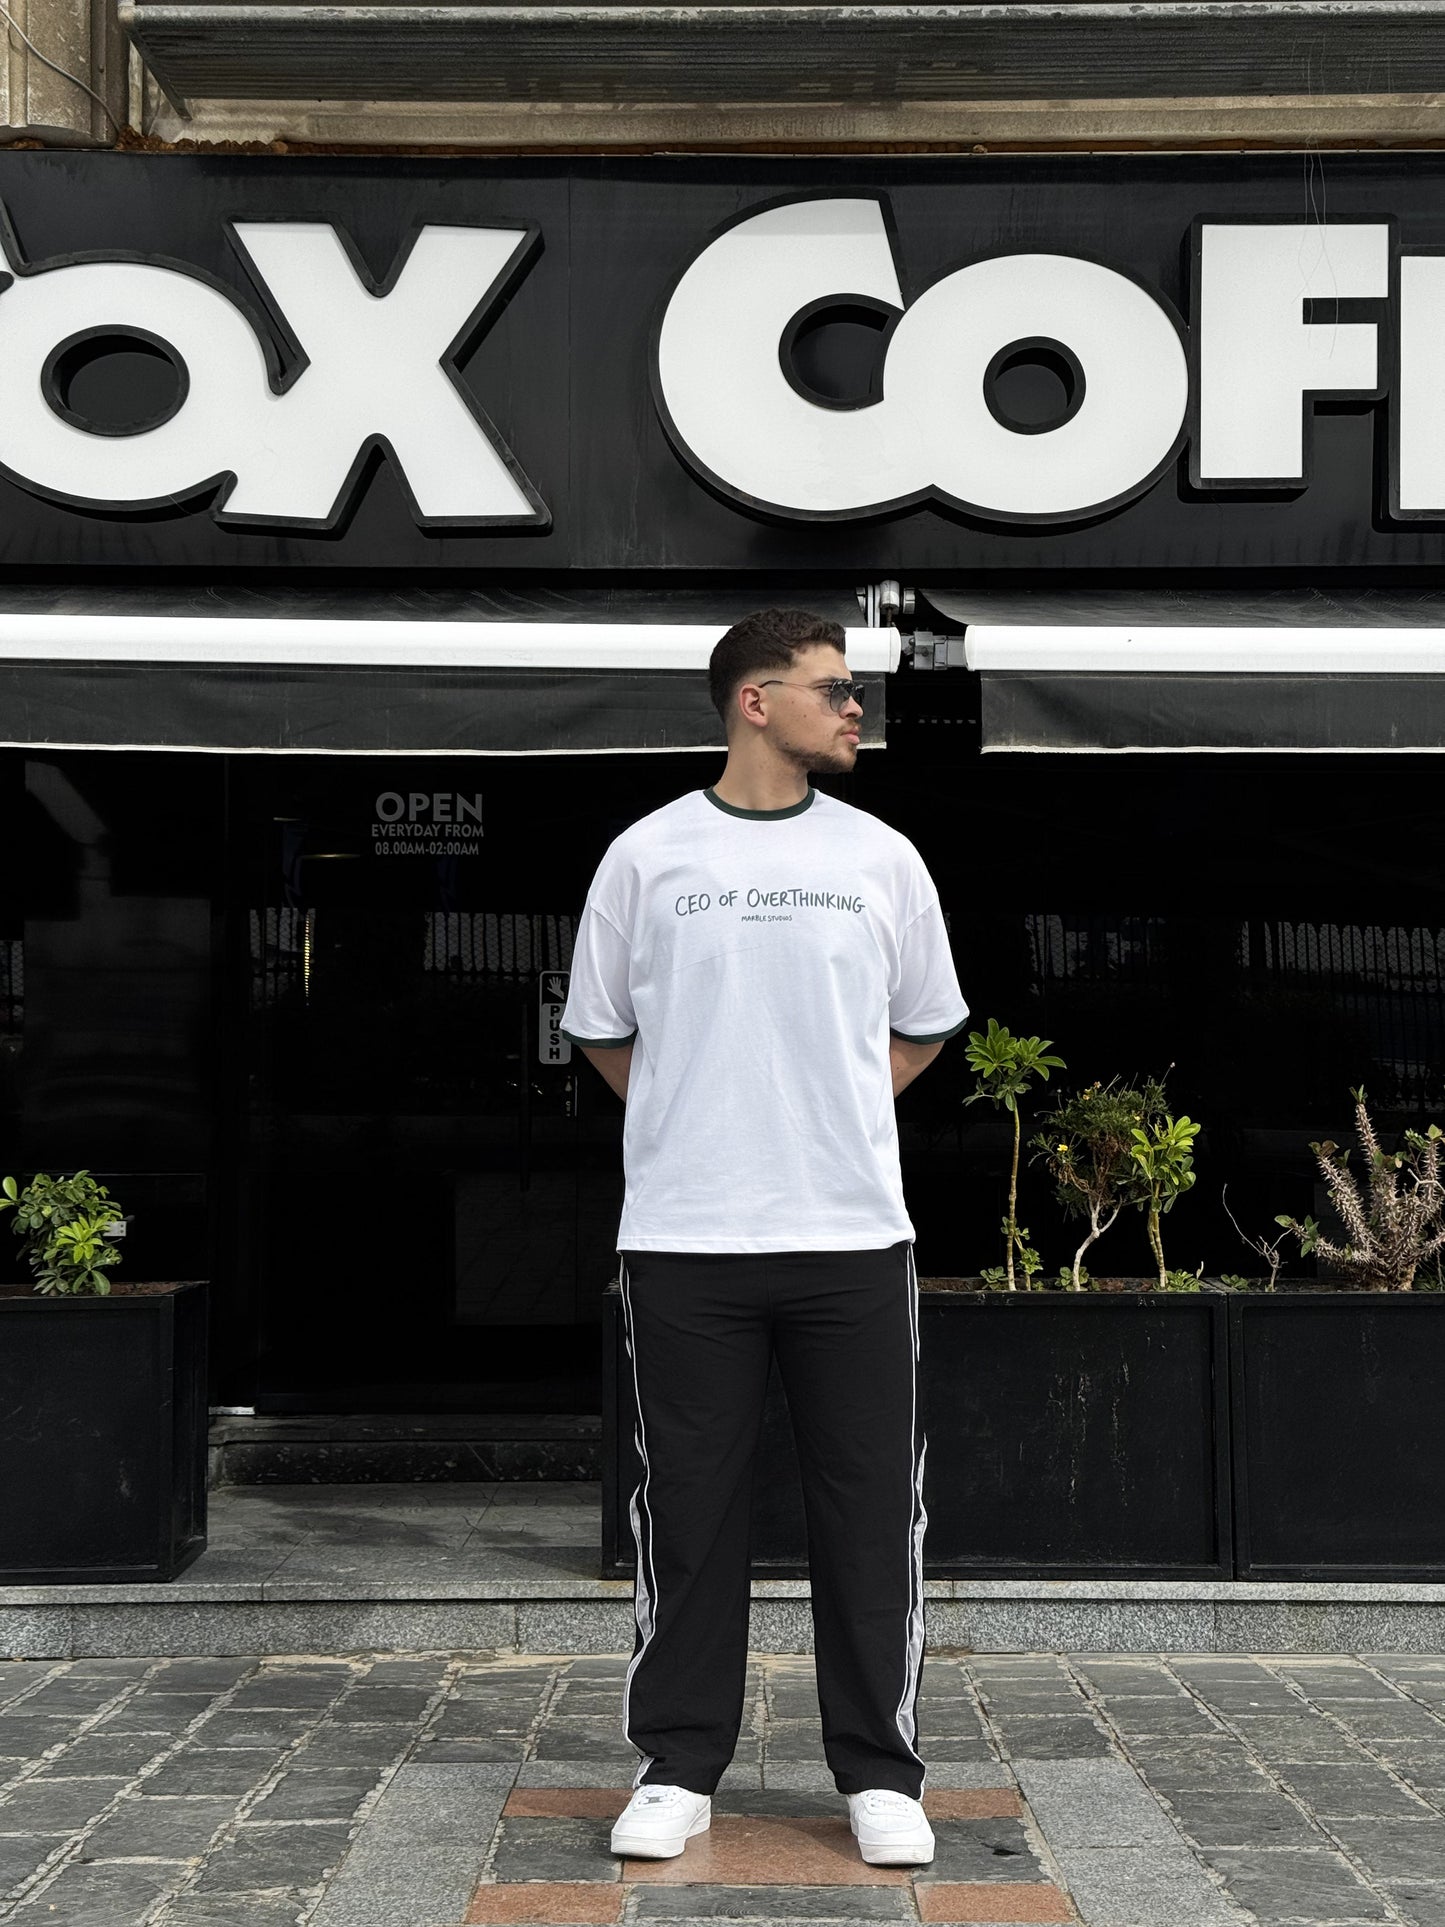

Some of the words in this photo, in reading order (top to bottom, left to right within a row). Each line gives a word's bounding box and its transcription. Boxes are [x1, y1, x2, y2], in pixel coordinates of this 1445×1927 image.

[0, 222, 538, 519] OX
[657, 197, 1445, 515] COF
[375, 791, 483, 823] OPEN
[371, 823, 441, 837] EVERYDAY
[445, 823, 484, 838] FROM
[375, 841, 479, 856] 08.00AM-02:00AM
[675, 893, 711, 916] CEO
[746, 888, 866, 913] OVERTHINKING
[741, 914, 767, 923] MARBLE
[549, 1004, 561, 1061] PUSH
